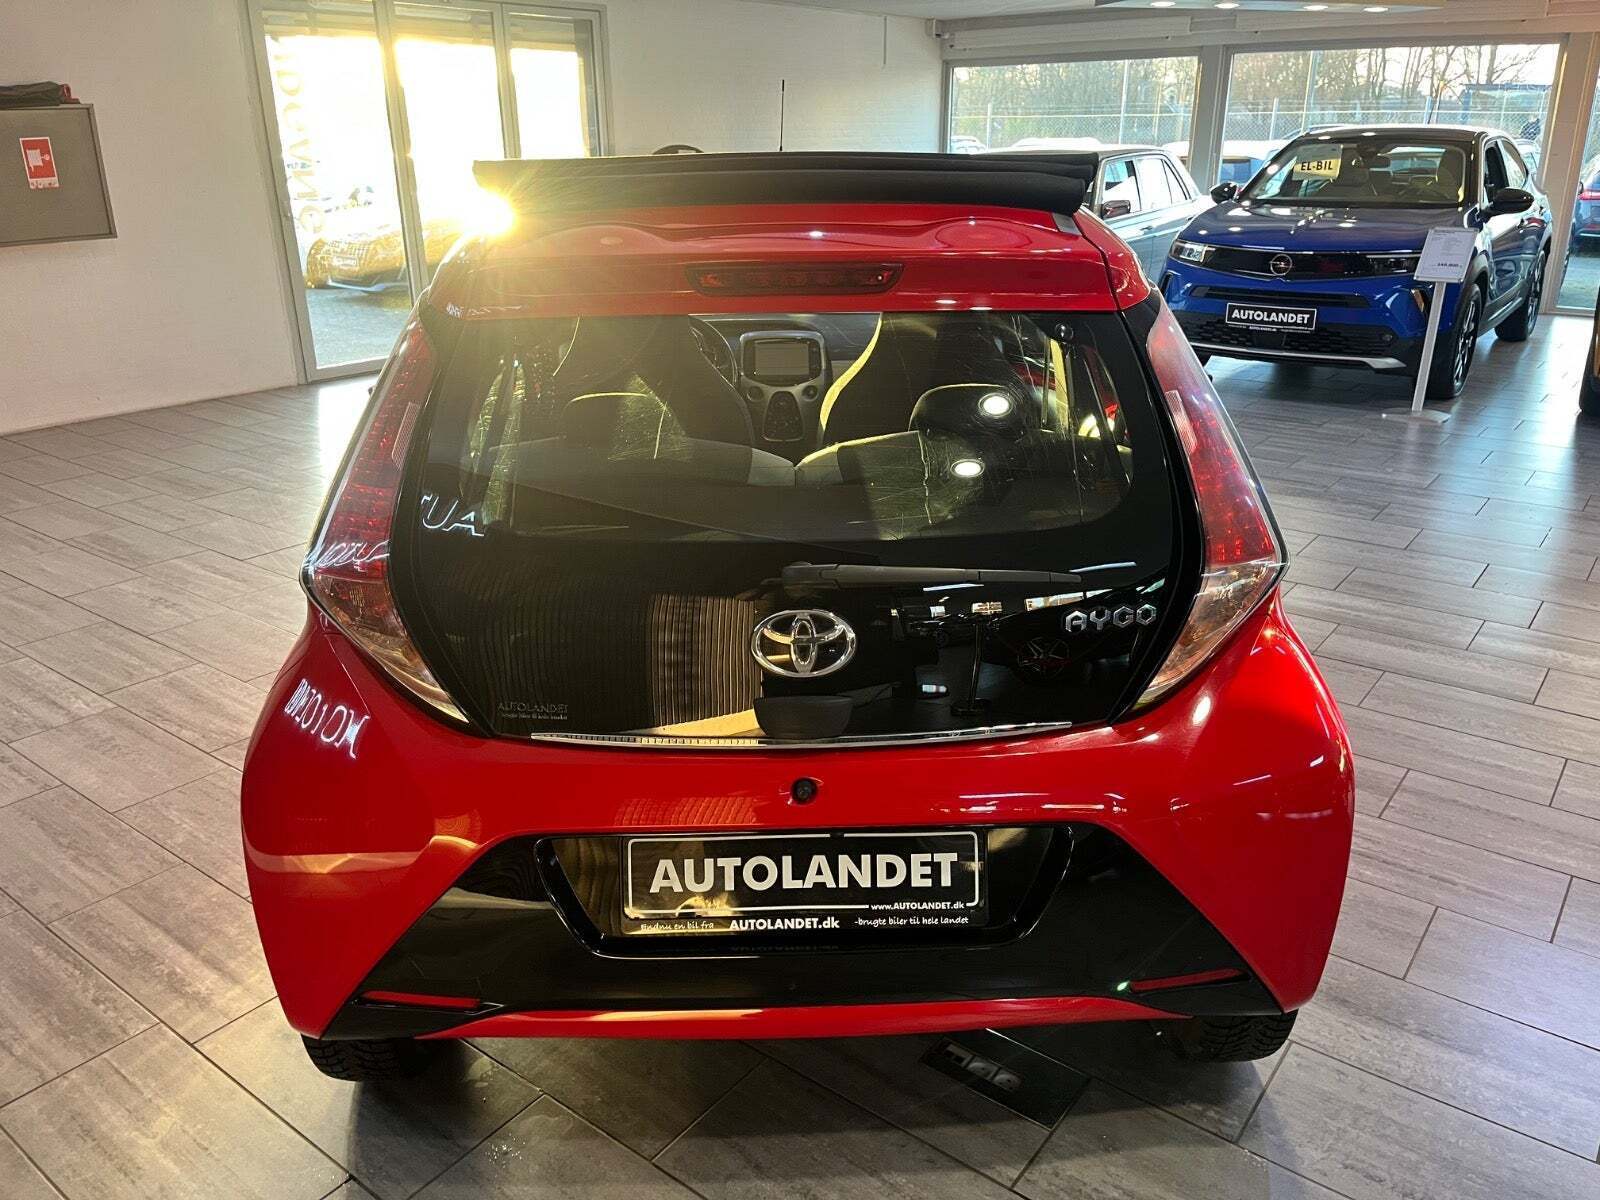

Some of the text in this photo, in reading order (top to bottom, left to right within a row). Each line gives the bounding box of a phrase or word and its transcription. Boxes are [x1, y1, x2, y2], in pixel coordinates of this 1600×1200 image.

[1301, 161, 1333, 171] EL-BIL
[1231, 309, 1310, 324] AUTOLANDET
[1065, 604, 1157, 632] AYGO
[649, 852, 958, 893] AUTOLANDET
[870, 901, 965, 910] www.AUTOLANDET.dk
[729, 916, 840, 930] AUTOLANDET.dk
[888, 916, 907, 925] biler
[909, 916, 921, 925] til
[940, 916, 969, 925] landet
